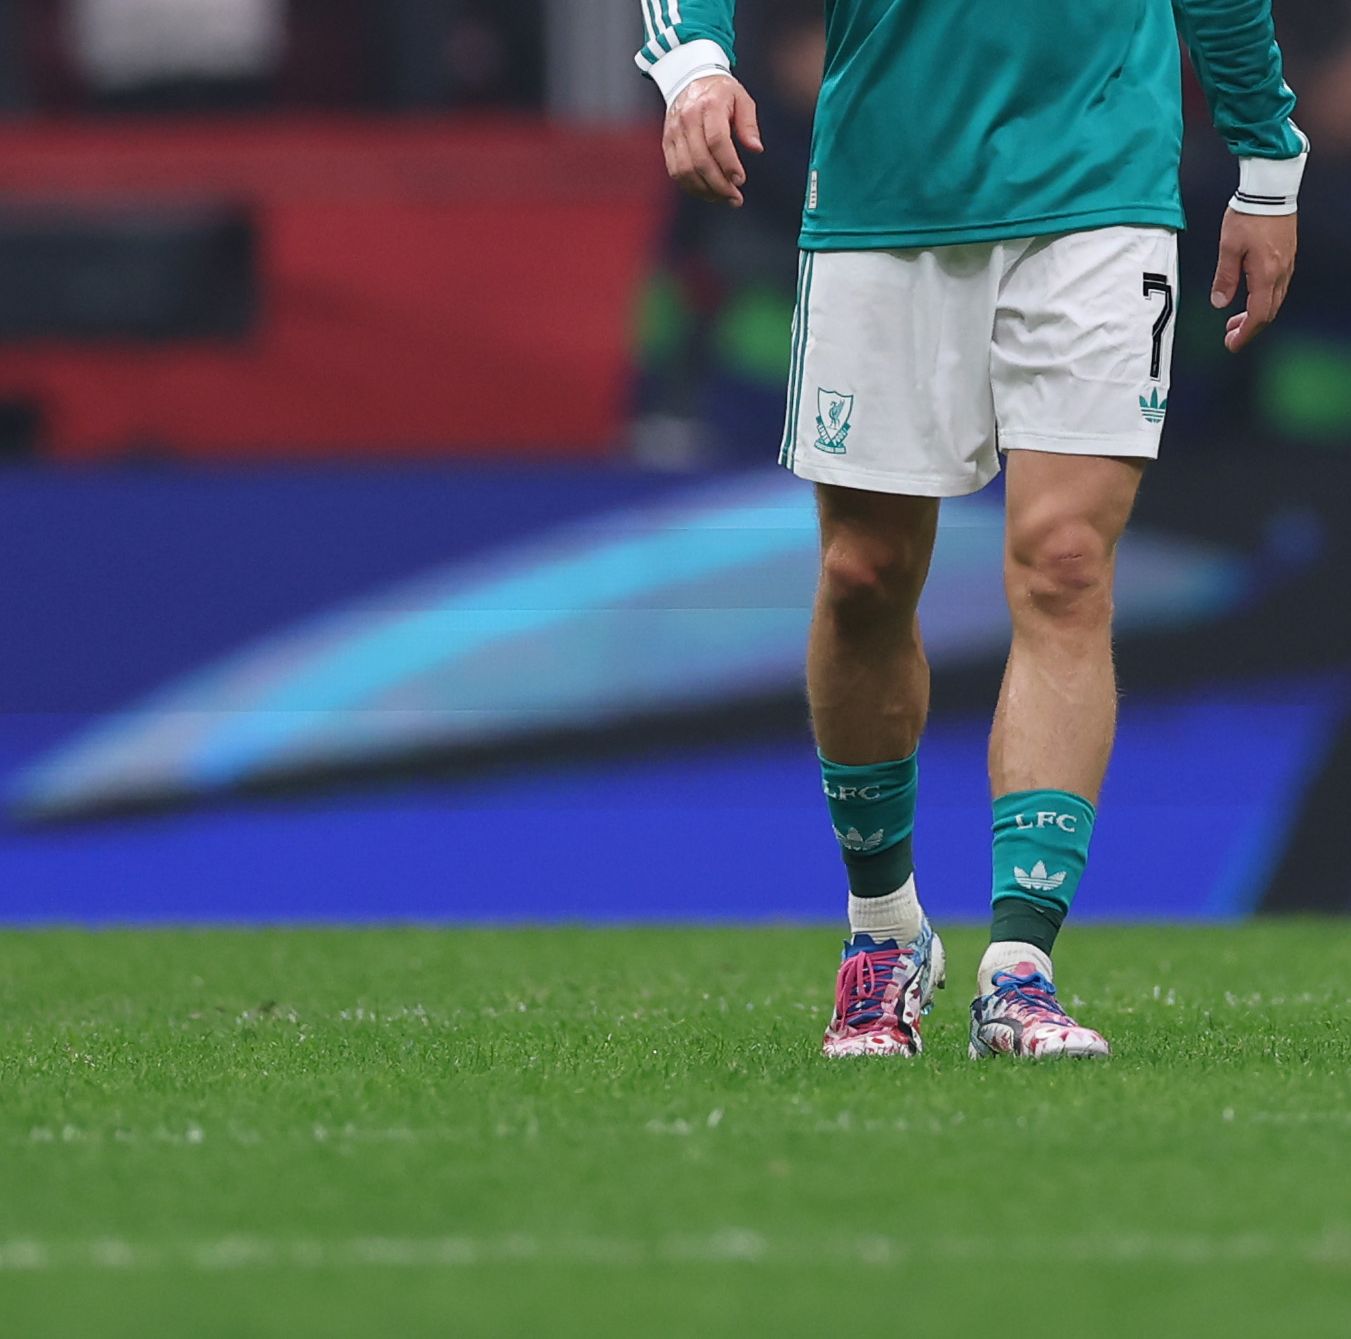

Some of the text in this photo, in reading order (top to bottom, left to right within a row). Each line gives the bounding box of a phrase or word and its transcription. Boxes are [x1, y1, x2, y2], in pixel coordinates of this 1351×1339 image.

[1143, 272, 1173, 380] 7
[822, 778, 881, 801] LFC
[1015, 811, 1078, 833] LFC
